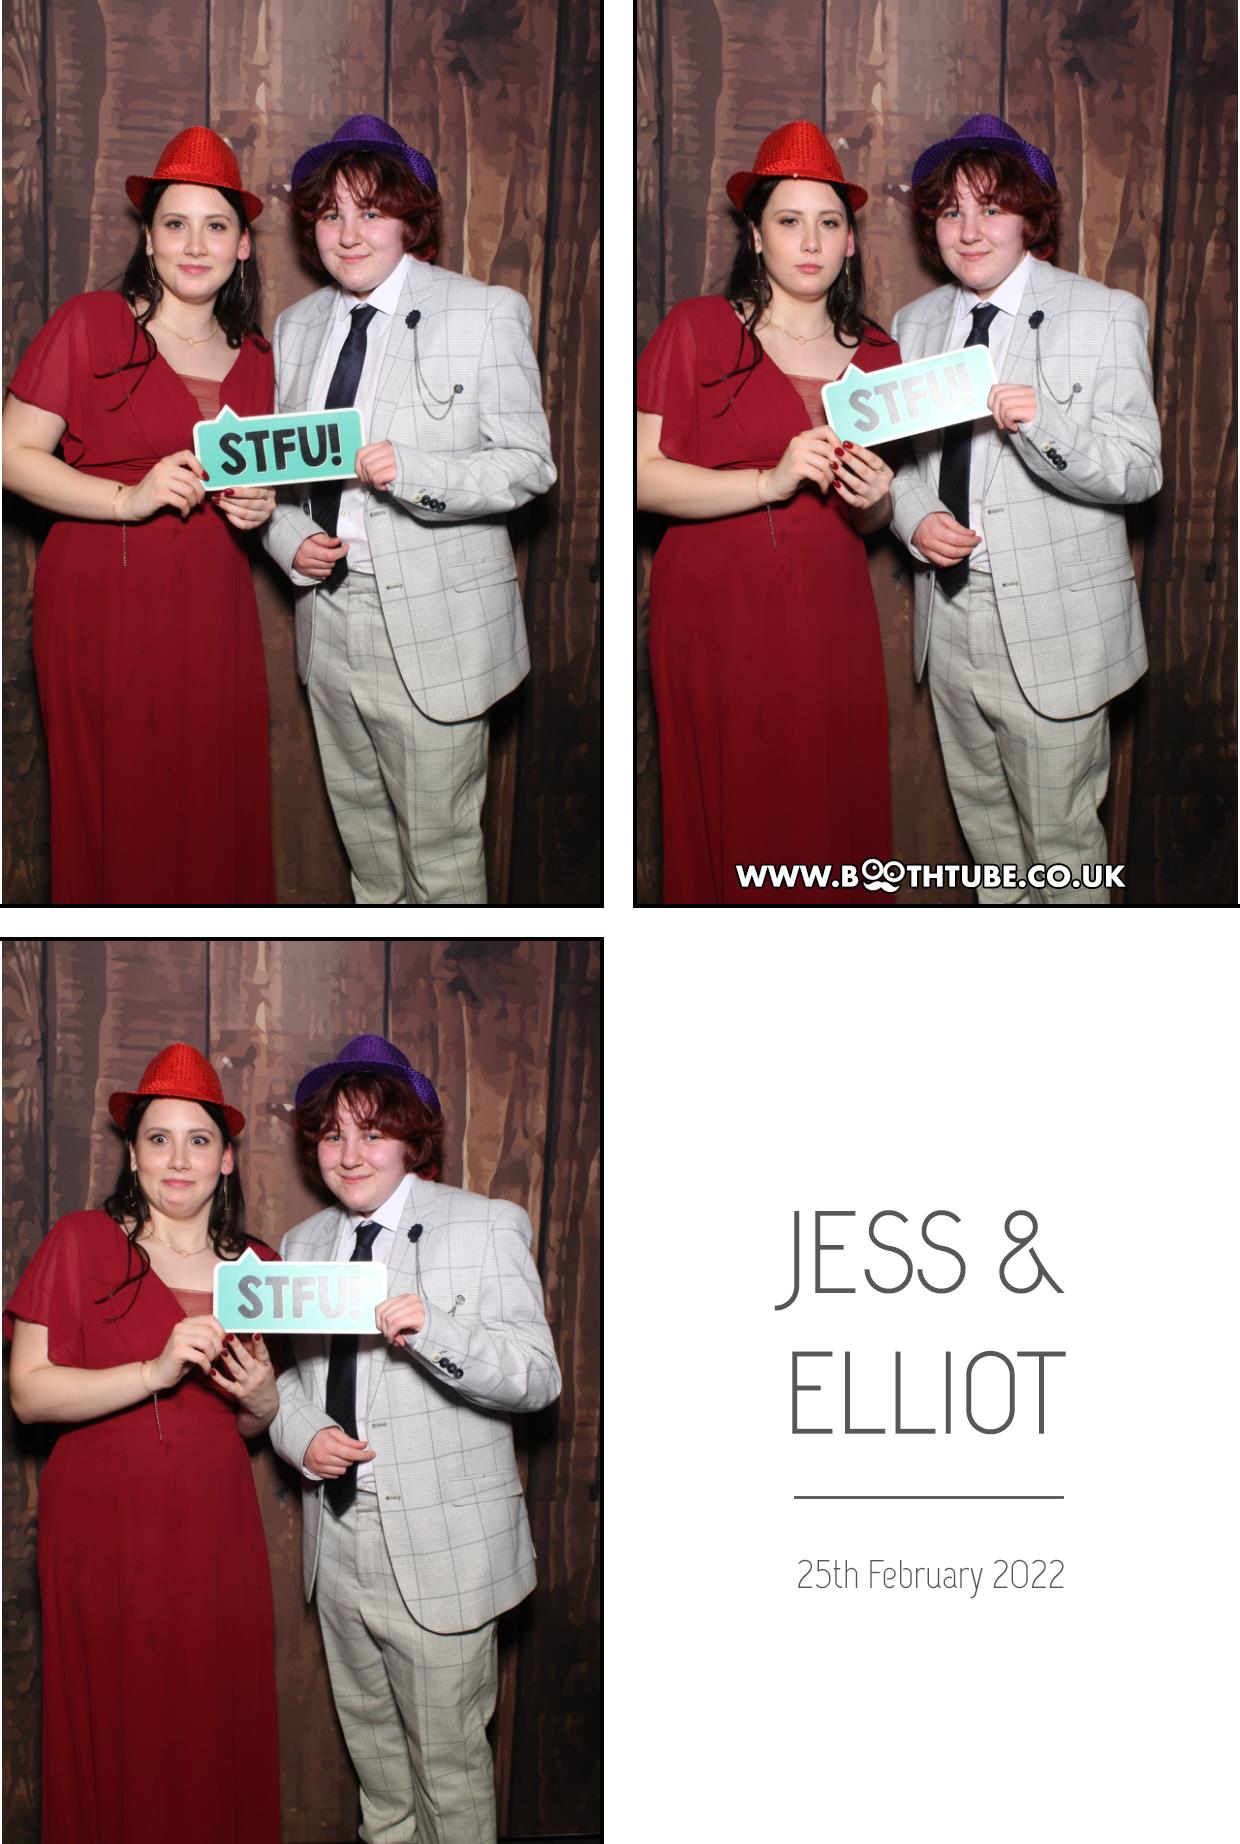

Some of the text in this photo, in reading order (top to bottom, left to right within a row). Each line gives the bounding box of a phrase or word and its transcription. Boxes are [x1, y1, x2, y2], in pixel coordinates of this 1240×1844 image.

[849, 362, 976, 432] STFU!
[219, 423, 342, 475] STFU!
[237, 1275, 361, 1319] STFU!
